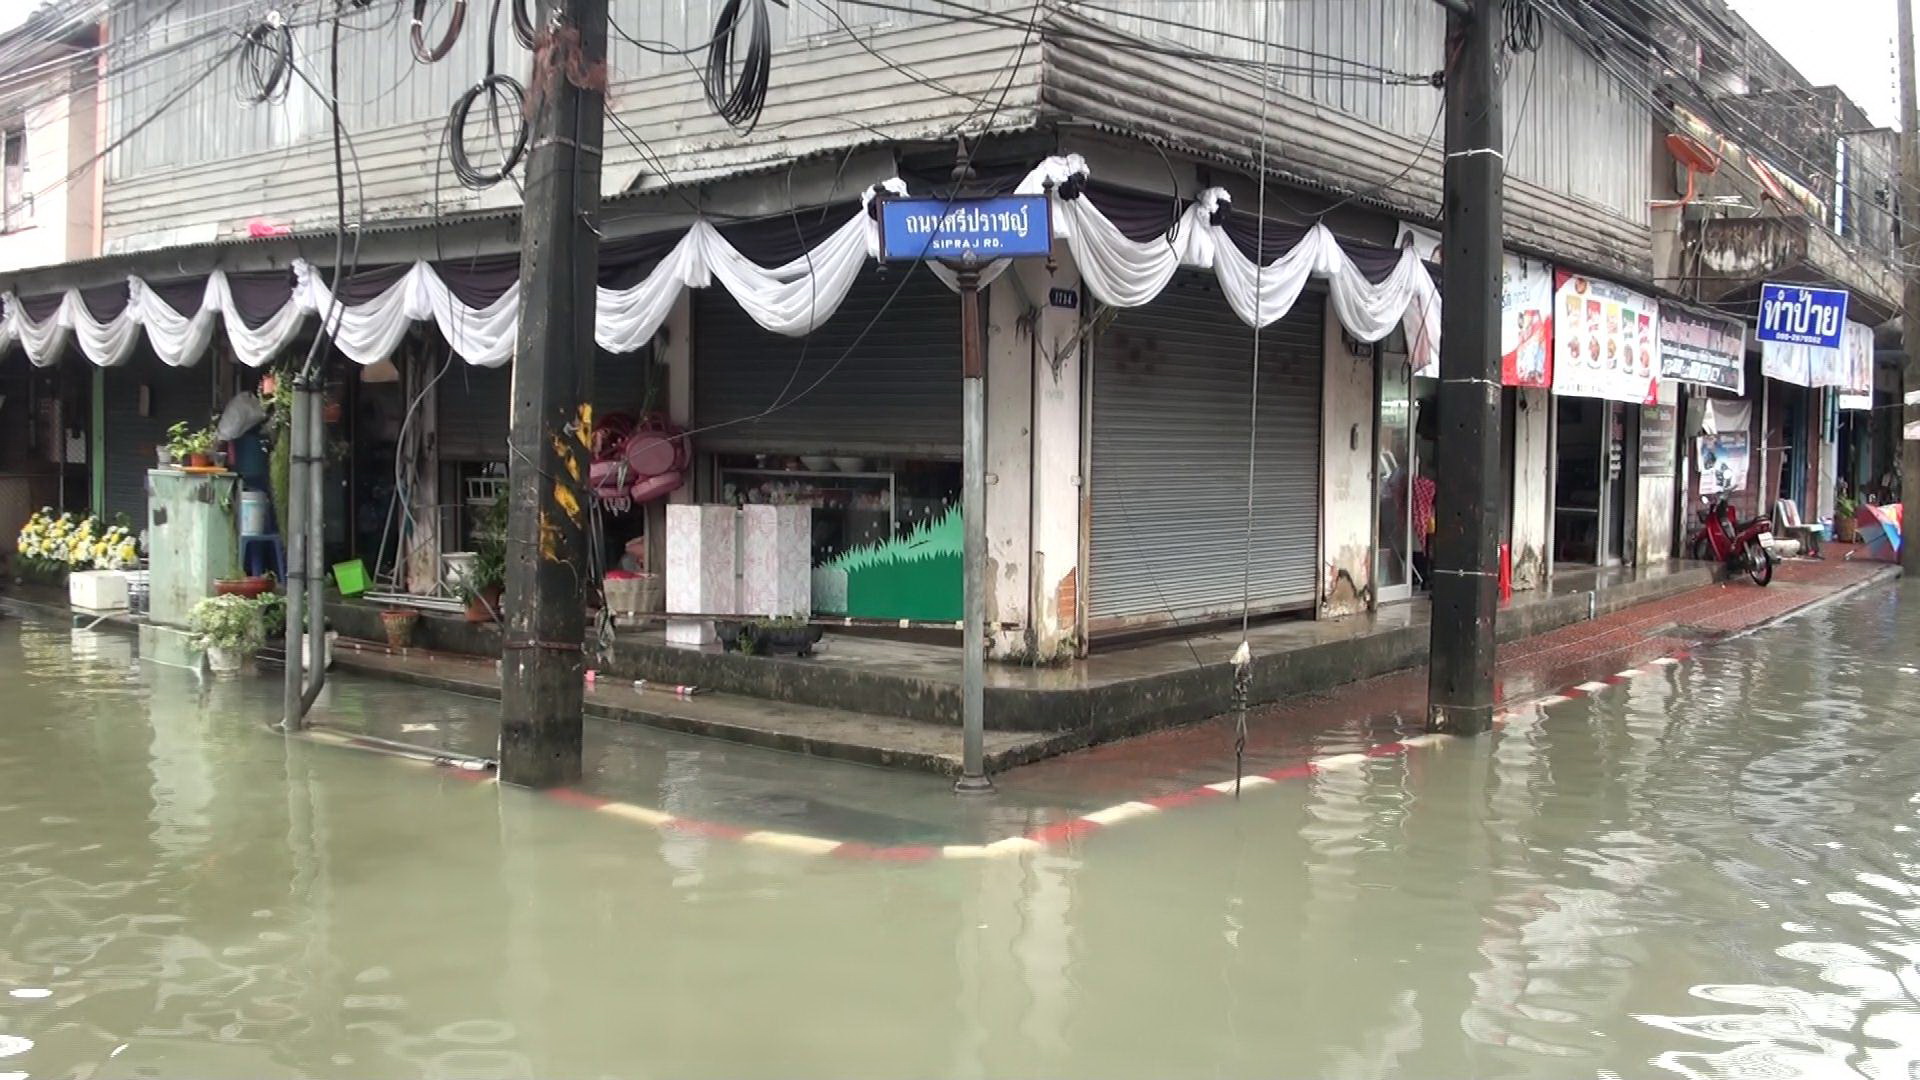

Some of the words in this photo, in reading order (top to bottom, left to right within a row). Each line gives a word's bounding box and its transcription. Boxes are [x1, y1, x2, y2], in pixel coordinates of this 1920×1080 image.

[906, 205, 1028, 237] ถนนศรีปราชญ์
[932, 238, 979, 249] SIPRAJ
[984, 238, 1003, 248] RD.
[1765, 290, 1839, 336] ทำป้าย
